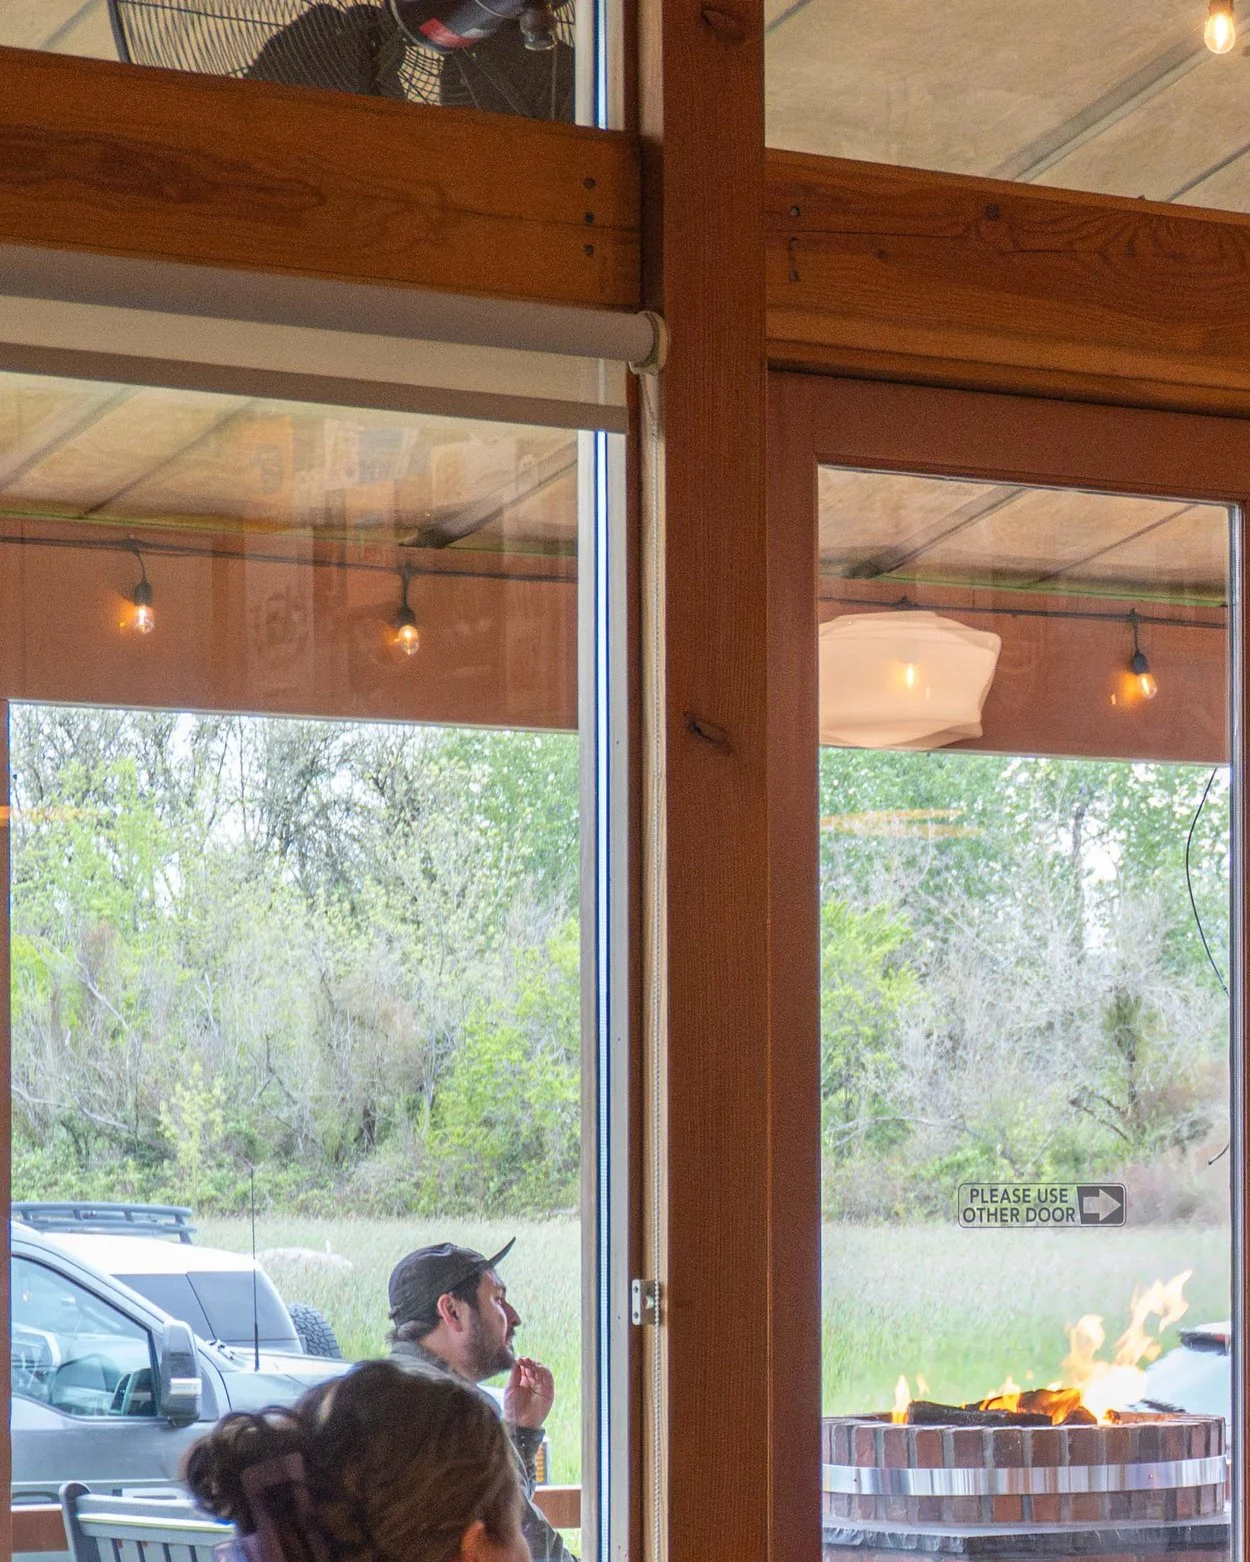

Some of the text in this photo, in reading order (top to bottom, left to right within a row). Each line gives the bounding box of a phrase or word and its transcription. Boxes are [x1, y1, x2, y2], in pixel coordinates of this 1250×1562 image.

[970, 1188, 1068, 1204] PLEASE USE
[963, 1207, 1076, 1223] OTHER DOOR
